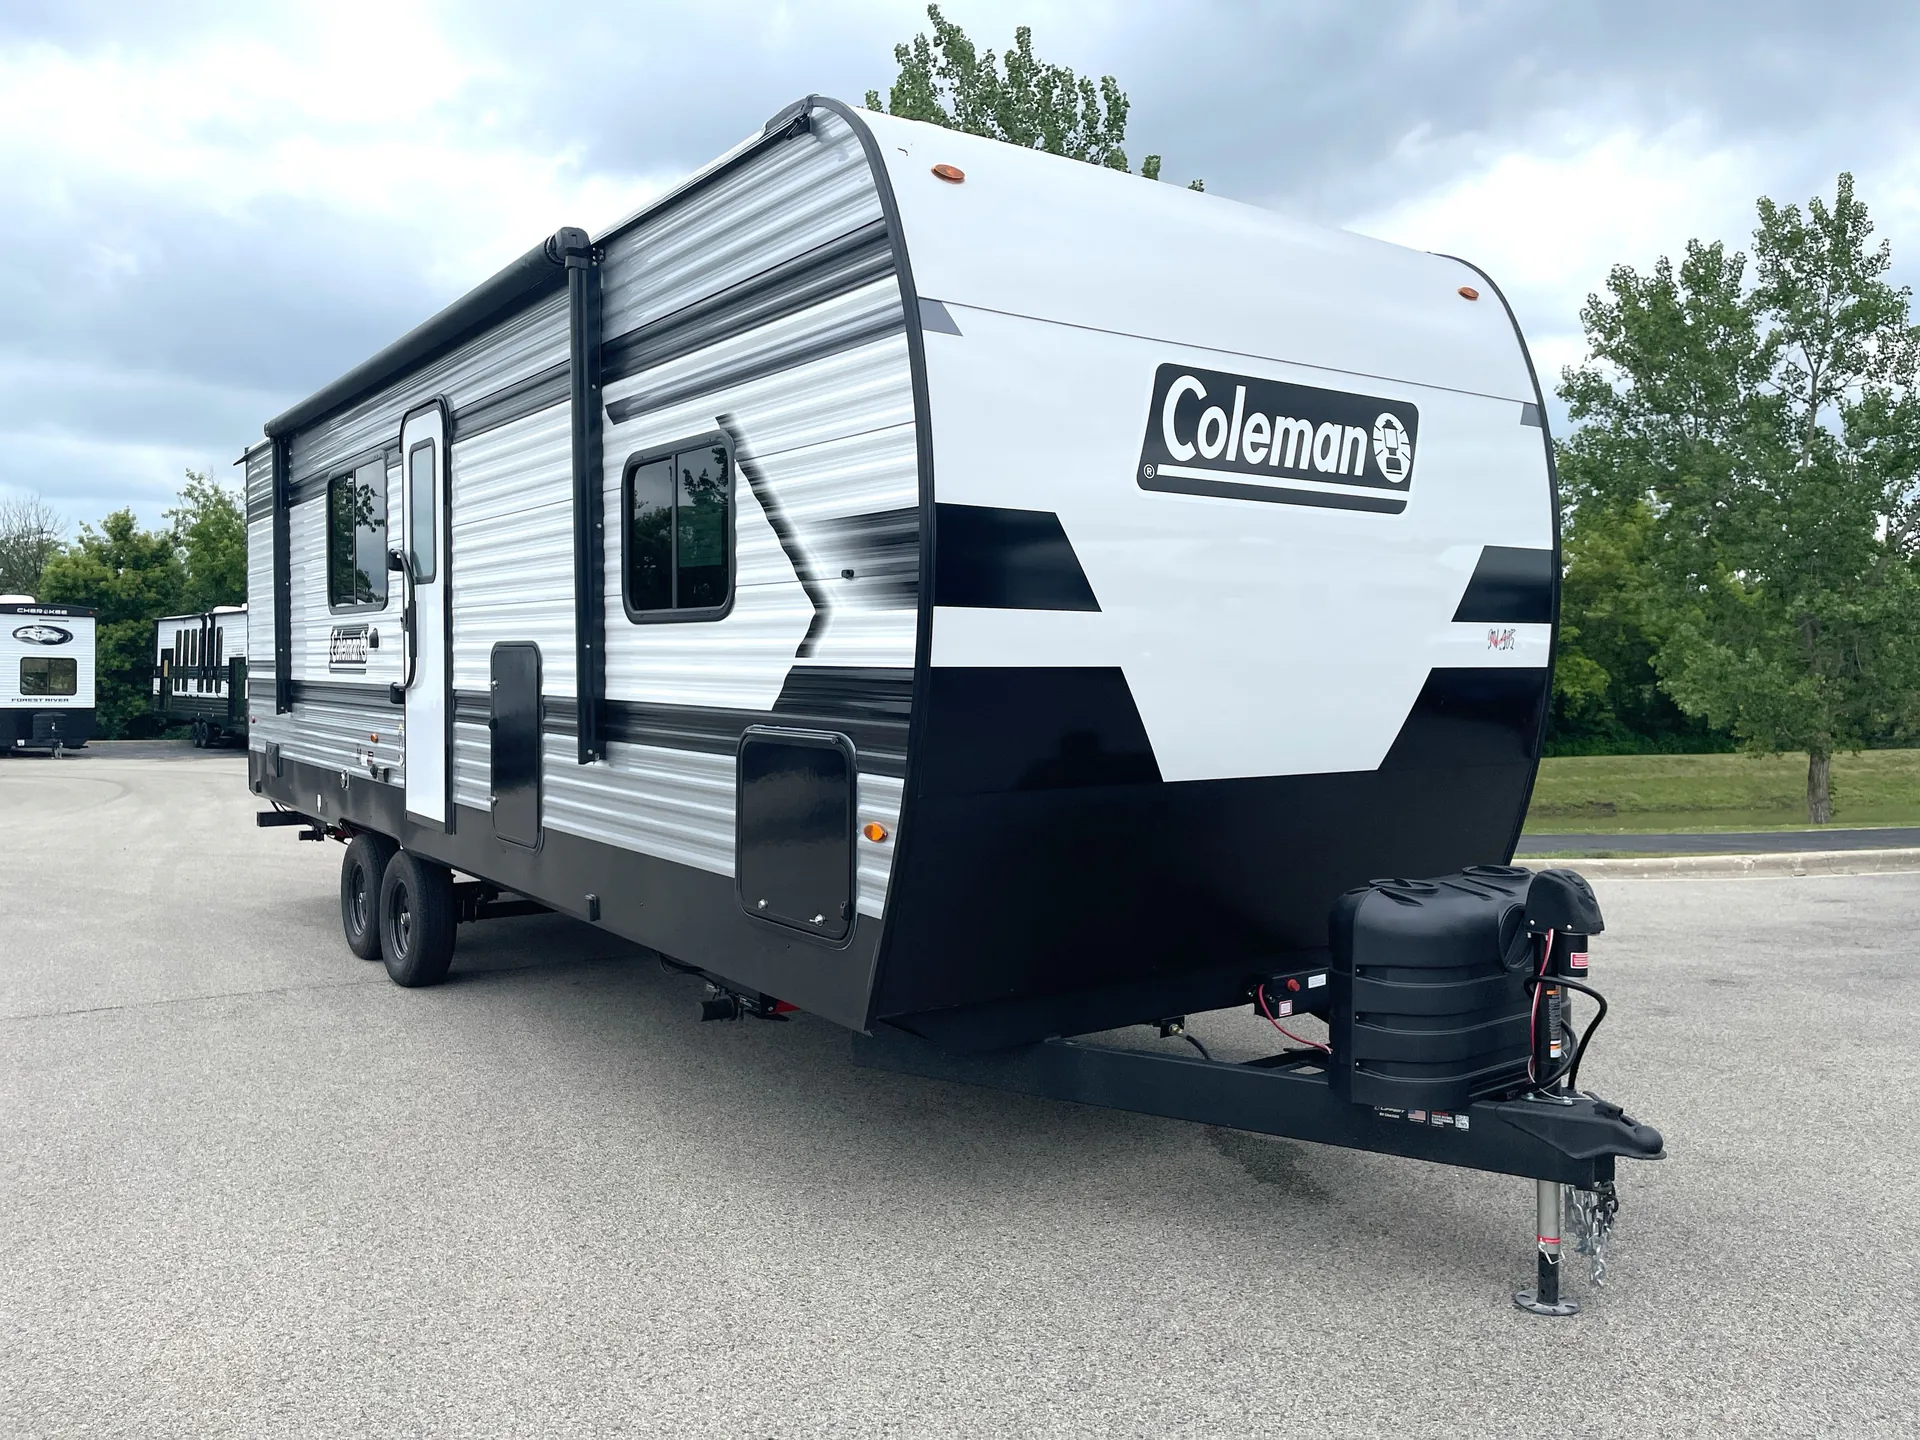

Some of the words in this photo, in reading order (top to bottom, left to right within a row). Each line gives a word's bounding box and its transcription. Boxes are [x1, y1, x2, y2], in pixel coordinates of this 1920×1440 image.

[1162, 374, 1368, 477] Coleman
[16, 607, 68, 615] CHEROKEE
[331, 629, 361, 663] Coleman
